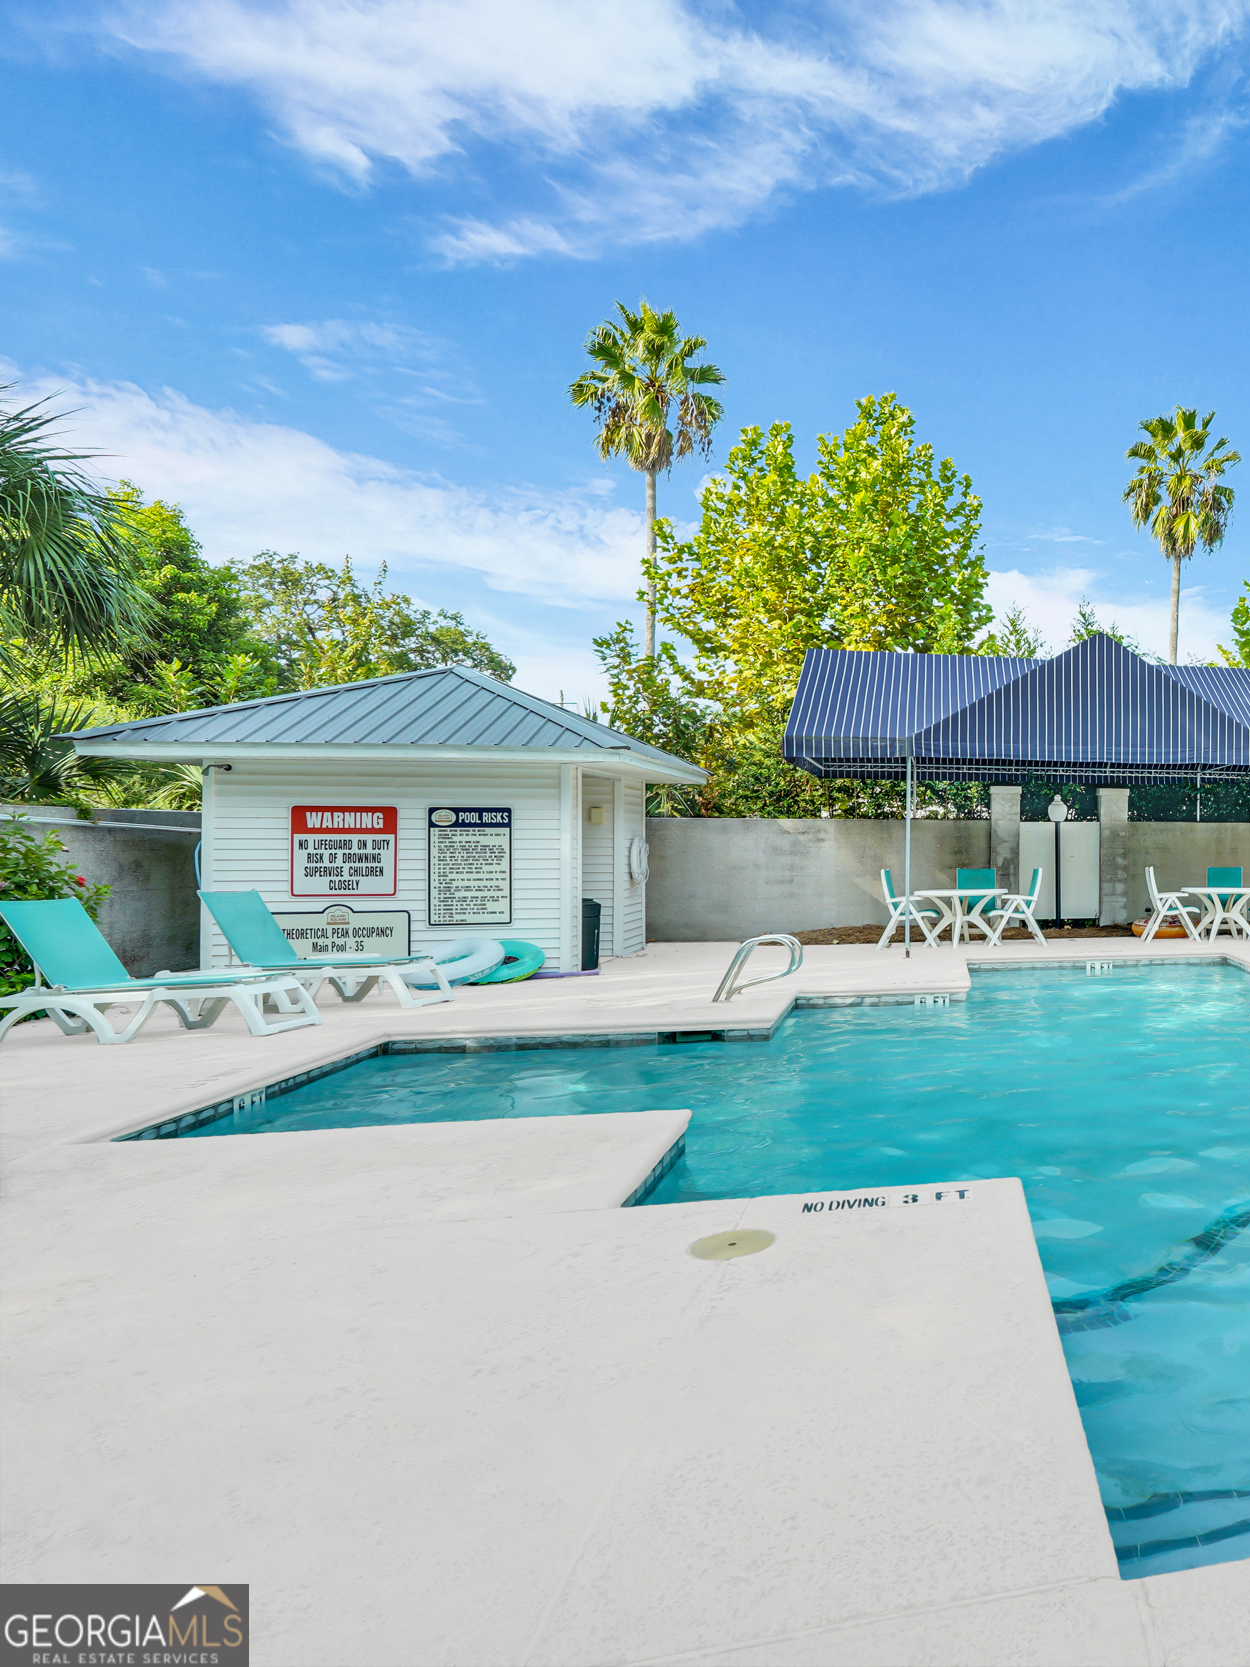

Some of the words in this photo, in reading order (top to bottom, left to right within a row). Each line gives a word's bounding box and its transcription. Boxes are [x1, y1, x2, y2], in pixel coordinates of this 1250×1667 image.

[305, 811, 384, 829] WARNING
[458, 811, 481, 823] POOL
[482, 811, 509, 824] RISKS
[298, 839, 309, 850] NO
[313, 839, 353, 850] LIFEGUARD
[357, 839, 367, 850] ON
[372, 839, 390, 850] DUTY
[307, 852, 324, 863] RISK
[329, 852, 338, 863] OF
[342, 852, 382, 863] DROWNING
[304, 866, 344, 877] SUPERVISE
[348, 866, 384, 877] CHILDREN
[328, 879, 360, 891] CLOSELY
[282, 927, 329, 940] THEORETICAL
[331, 927, 350, 939] PEAK
[352, 926, 394, 939] OCCUPANCY
[312, 941, 329, 953] Main
[331, 941, 347, 953] Pool
[354, 940, 364, 952] 35
[801, 1201, 825, 1213] NO
[828, 1196, 886, 1211] DIVING
[902, 1194, 919, 1204] 3
